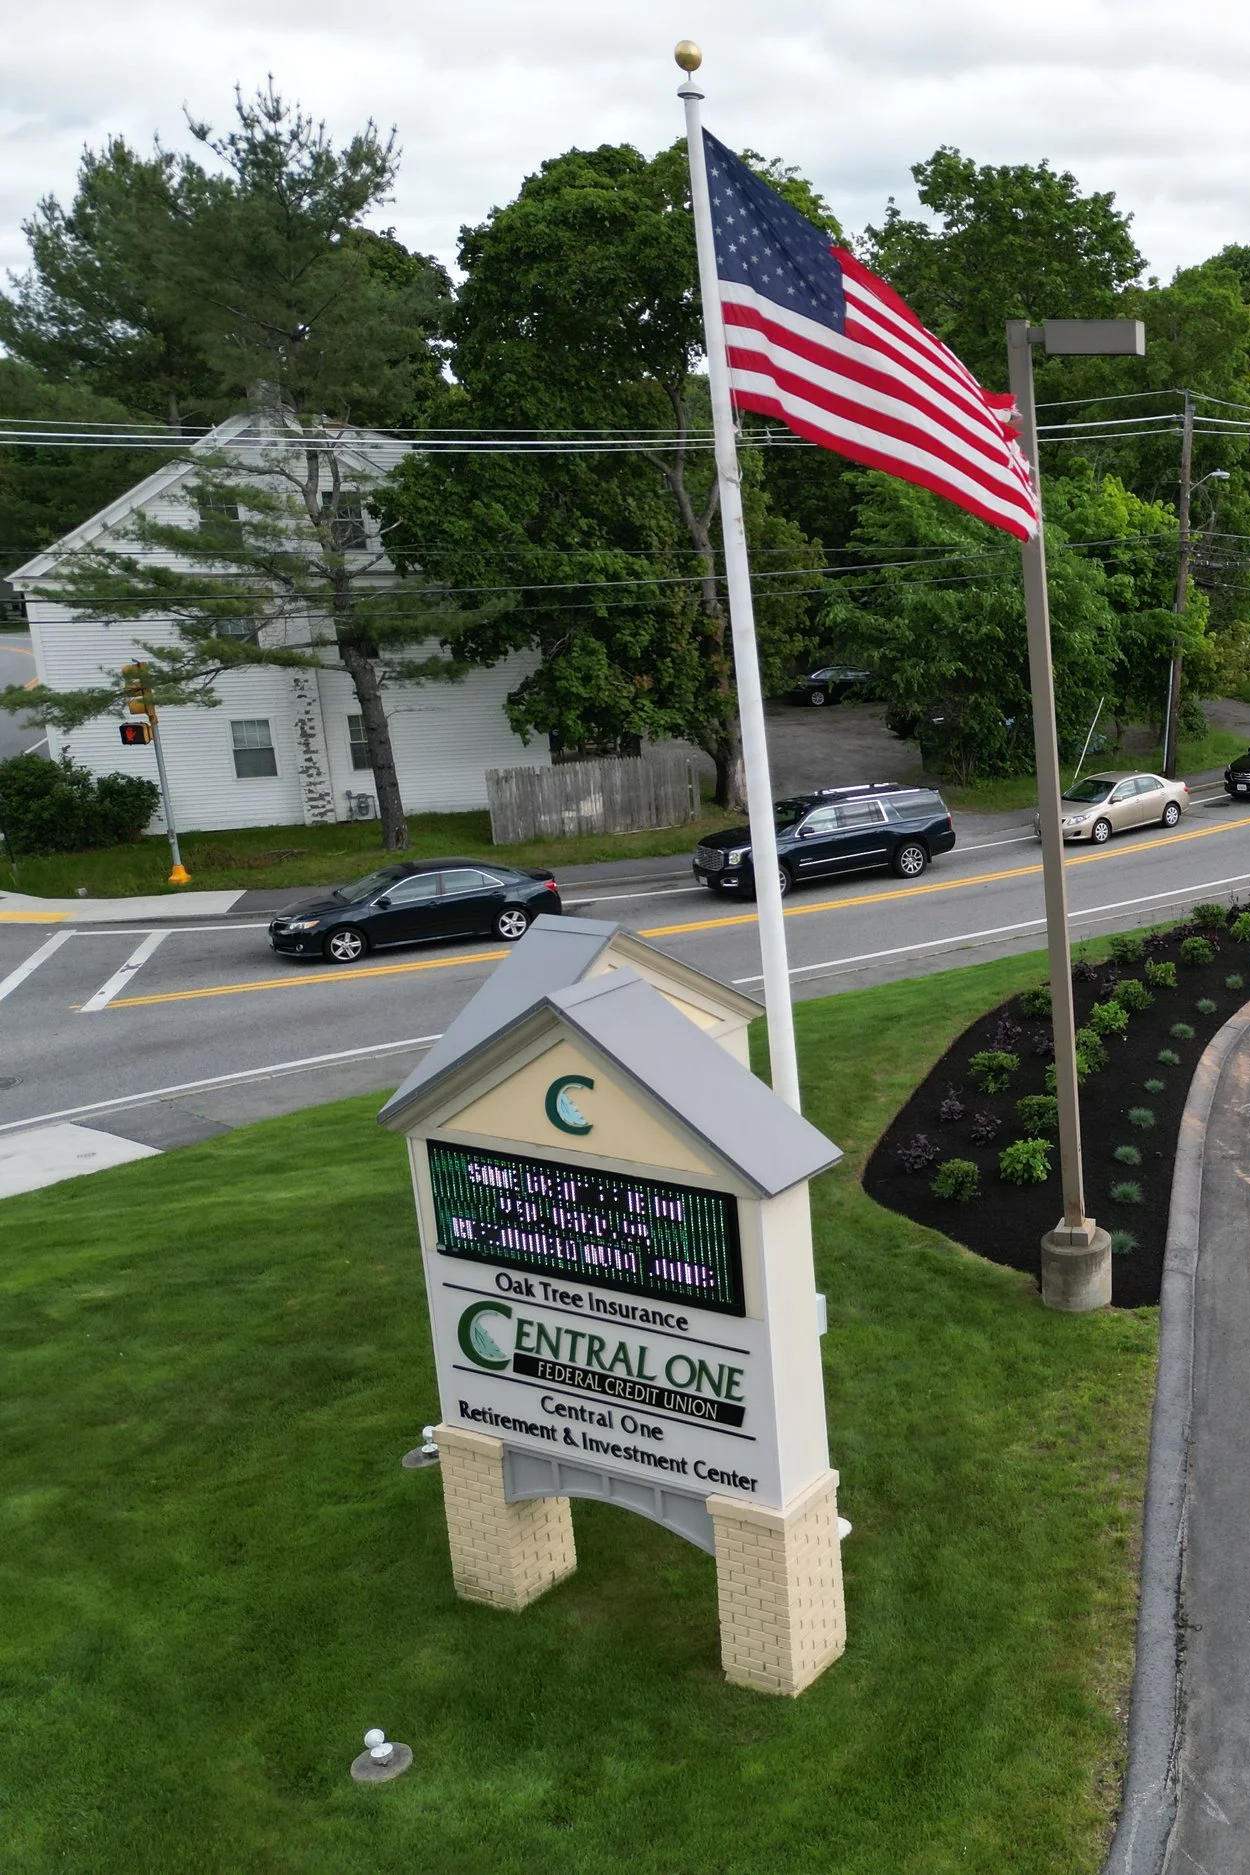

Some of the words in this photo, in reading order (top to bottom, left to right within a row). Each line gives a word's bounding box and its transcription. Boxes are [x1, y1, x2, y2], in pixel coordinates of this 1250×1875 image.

[495, 1272, 536, 1298] Oak
[539, 1281, 584, 1308] Tree
[588, 1292, 689, 1332] Insurance
[457, 1300, 657, 1381] CENTRAL
[664, 1353, 745, 1402] ONE
[537, 1361, 602, 1391] FEDERAL
[604, 1378, 660, 1404] CREDIT
[664, 1392, 718, 1420] UNION
[541, 1395, 613, 1430] Central
[620, 1415, 664, 1441] One
[458, 1400, 557, 1442] Retirement
[562, 1430, 580, 1448] &
[582, 1432, 688, 1475] Investment
[693, 1460, 758, 1493] Center
